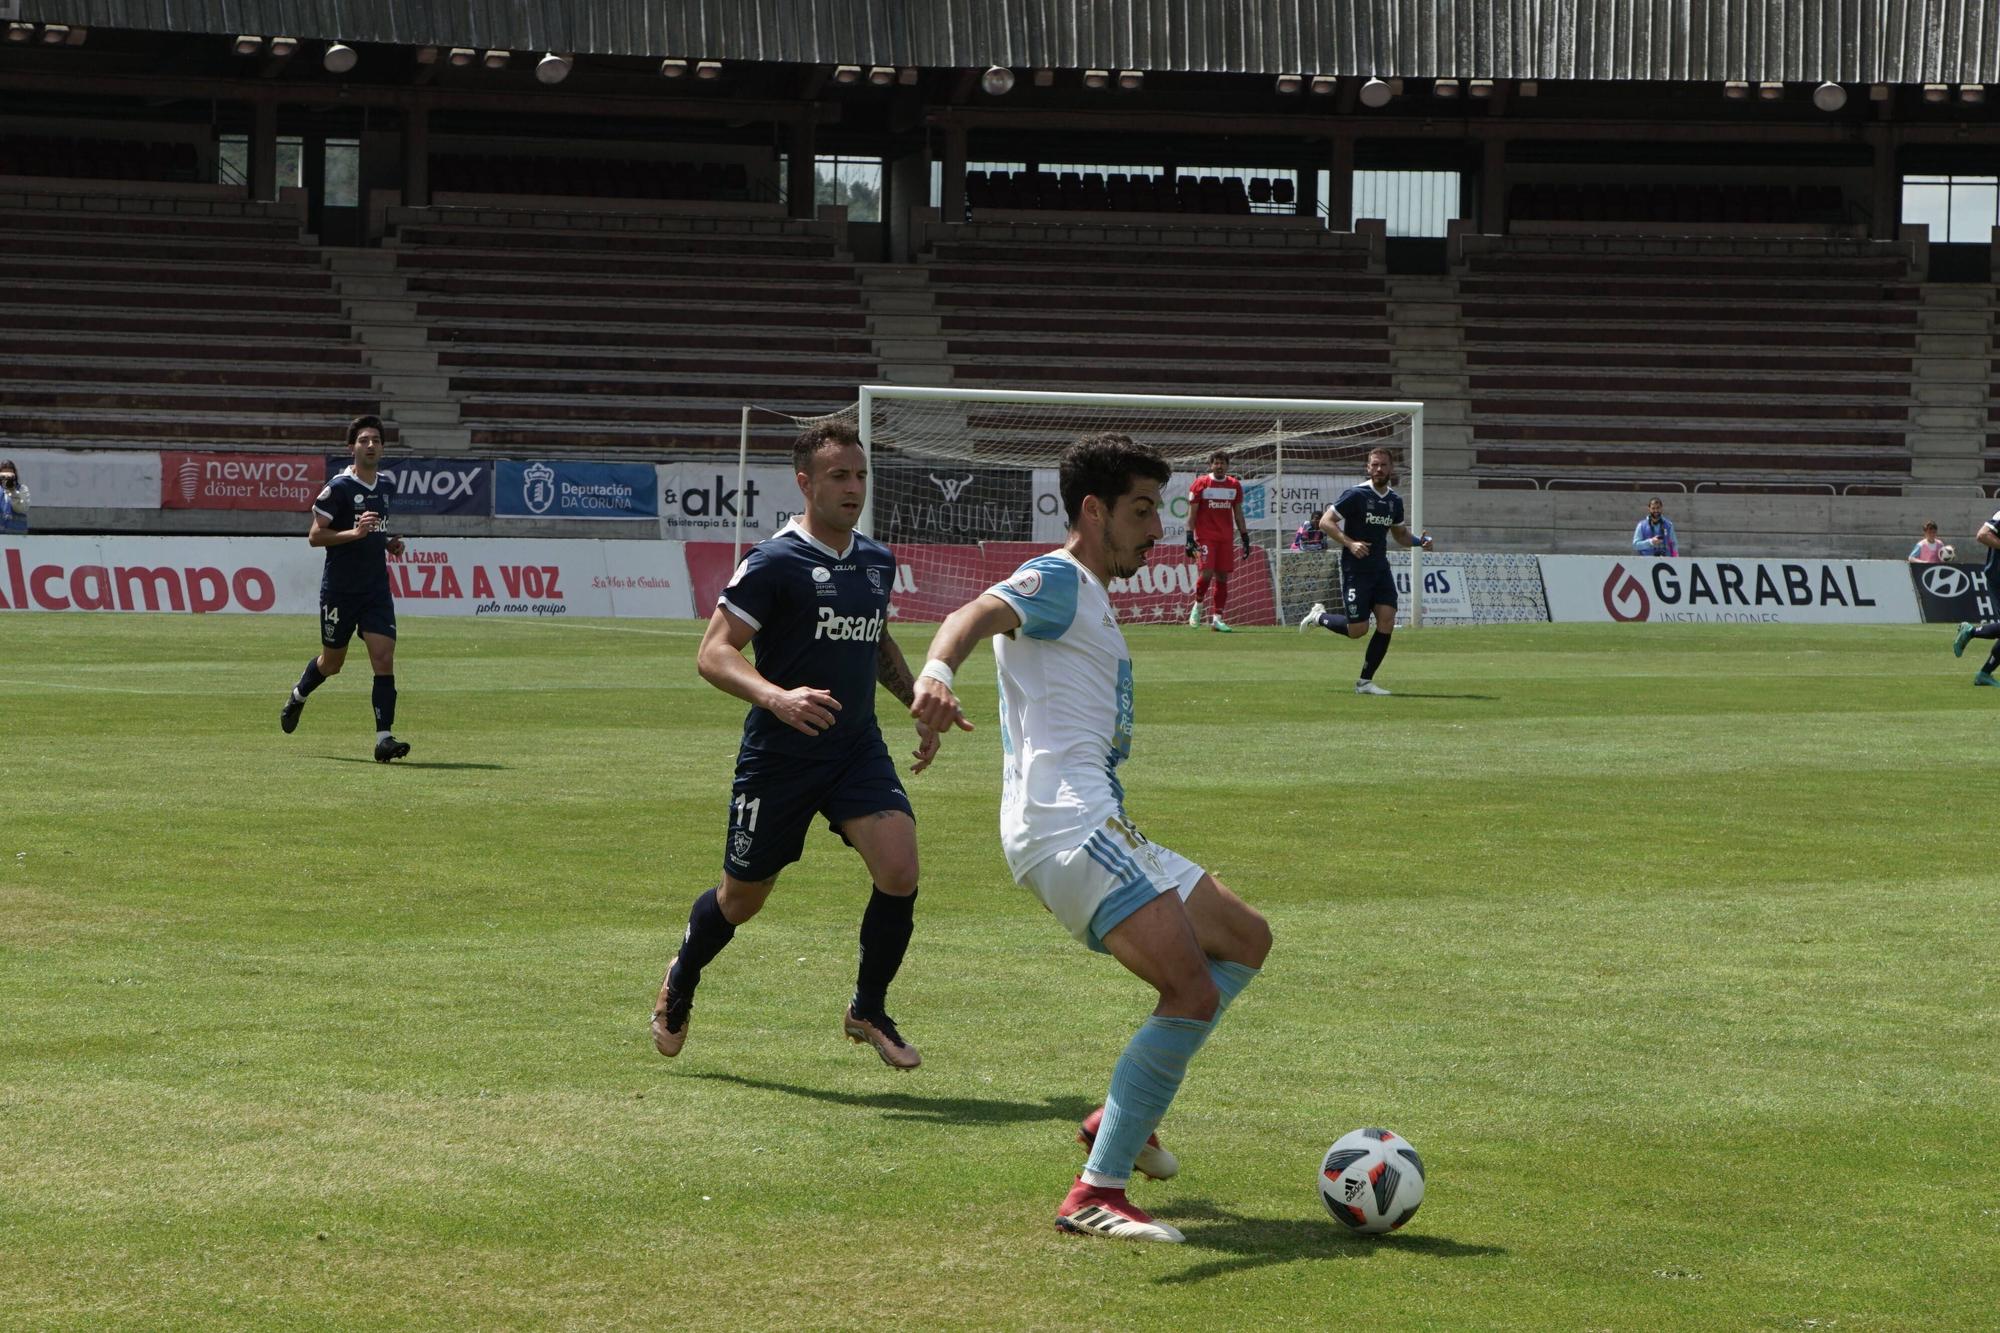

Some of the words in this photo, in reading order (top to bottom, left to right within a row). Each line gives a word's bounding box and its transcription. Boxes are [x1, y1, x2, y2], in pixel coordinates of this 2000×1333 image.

[206, 461, 308, 481] newroz
[204, 481, 254, 496] döner
[259, 482, 310, 502] kebap
[561, 482, 632, 498] Deputación
[681, 475, 760, 517] akt
[561, 496, 578, 508] DA
[581, 496, 632, 509] CORUÑA
[732, 519, 759, 528] slud
[405, 547, 448, 564] LÁZARO
[0, 549, 275, 613] lcampo
[472, 565, 495, 598] A
[499, 565, 563, 598] VOZ
[1651, 563, 1877, 606] GARABAL
[1348, 588, 1356, 601] 5
[322, 604, 340, 625] 14
[476, 601, 500, 616] polo
[503, 603, 528, 613] noso
[531, 602, 566, 616] equipo
[734, 792, 761, 832] 11
[1346, 1180, 1367, 1202] adidas
